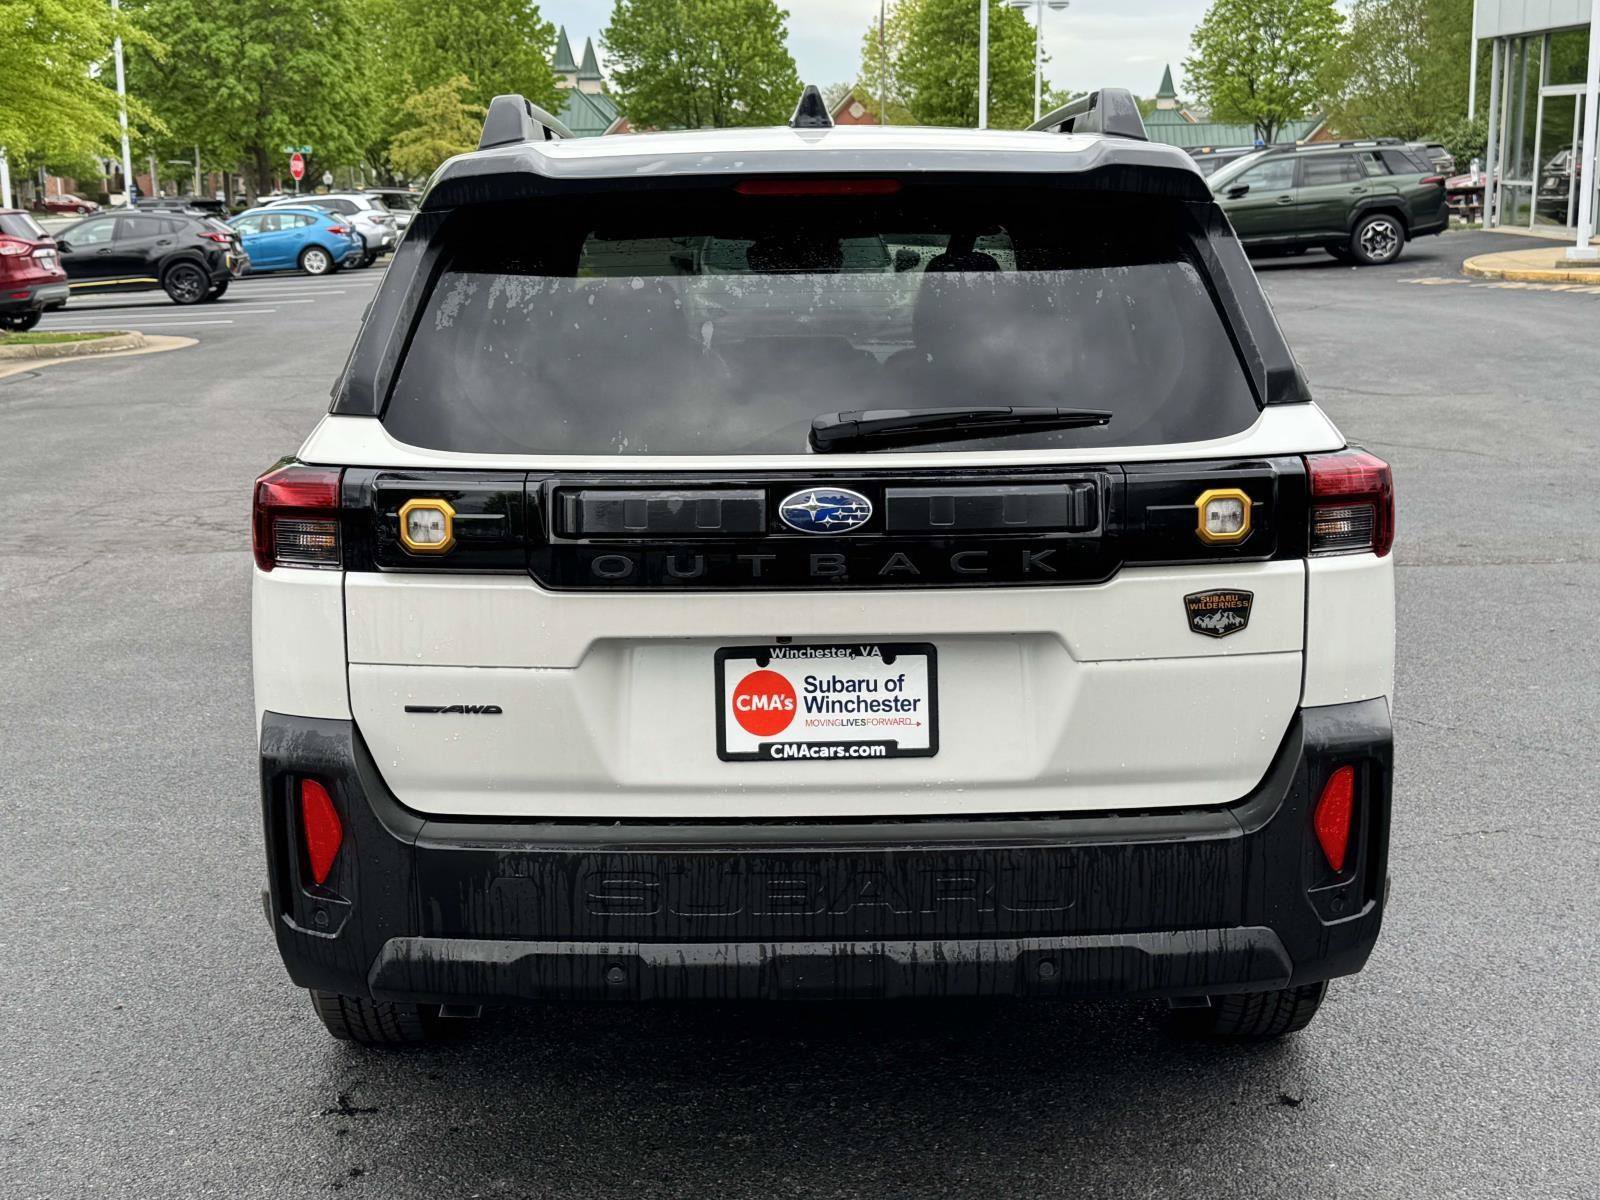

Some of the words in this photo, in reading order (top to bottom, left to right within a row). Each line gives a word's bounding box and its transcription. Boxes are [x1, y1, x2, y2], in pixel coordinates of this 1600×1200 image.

[591, 549, 1057, 578] OUTBACK
[1189, 601, 1249, 610] WILDERNESS
[1200, 595, 1239, 603] SUBARU
[770, 647, 856, 659] Winchester,
[860, 646, 882, 657] VA
[803, 675, 878, 693] Subaru
[884, 674, 905, 692] of
[736, 695, 794, 711] CMA's
[803, 695, 921, 713] Winchester
[770, 744, 886, 759] CMAcars.com
[584, 869, 1076, 917] SUBARU
